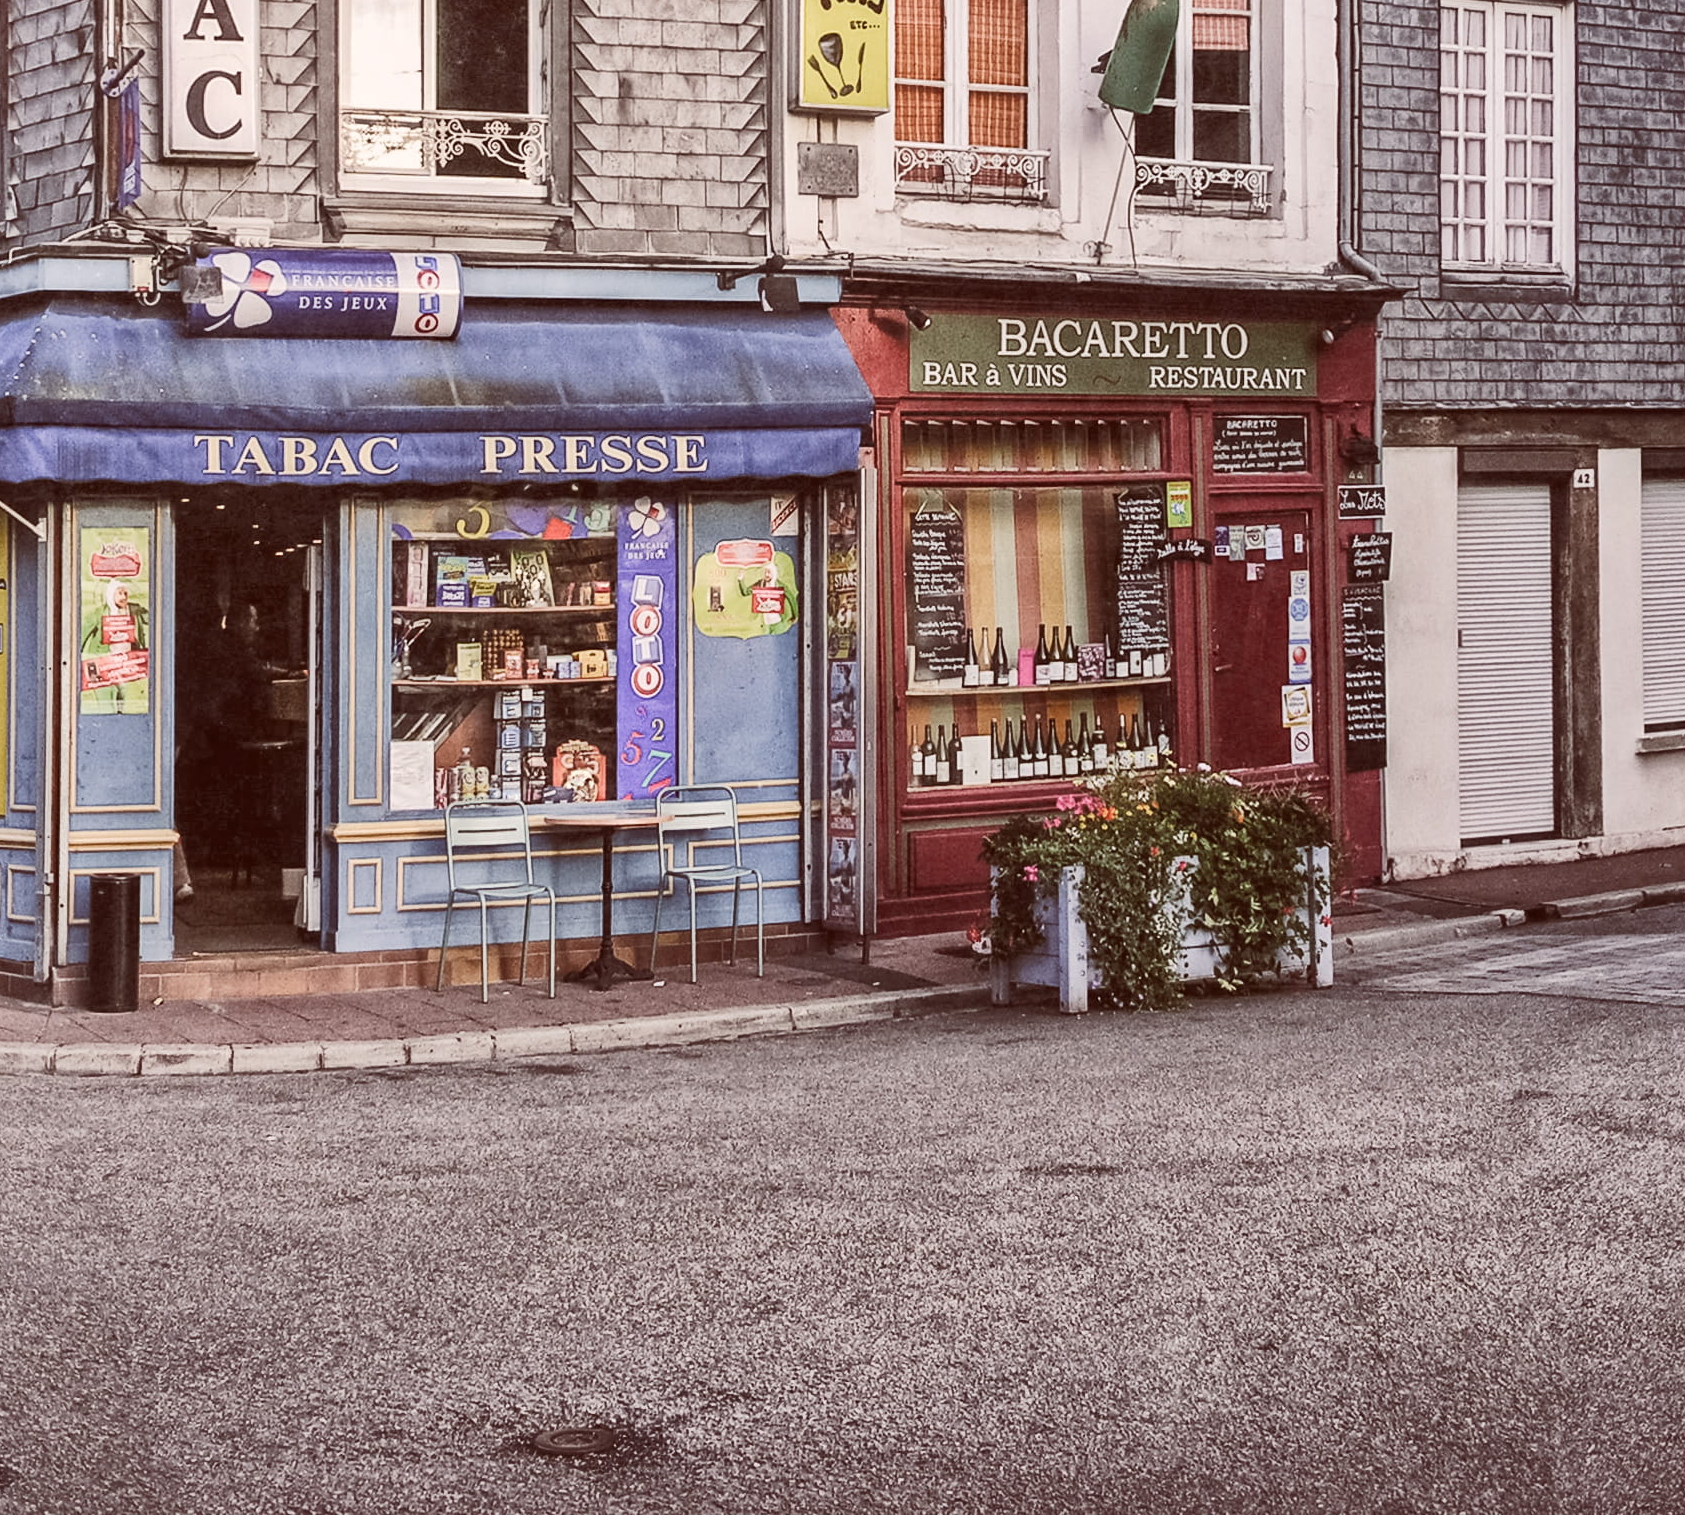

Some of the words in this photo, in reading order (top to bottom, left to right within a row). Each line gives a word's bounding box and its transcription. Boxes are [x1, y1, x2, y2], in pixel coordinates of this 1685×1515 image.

[298, 296, 333, 310] DES
[340, 296, 388, 312] JEUX
[997, 318, 1249, 360] BACARETTO
[922, 362, 978, 386] BAR
[986, 363, 1000, 386] à
[1007, 365, 1067, 387] VINS
[1149, 366, 1306, 390] RESTAURANT
[1226, 419, 1278, 430] BACARETTO
[193, 434, 399, 476] TABAC
[479, 434, 709, 475] PRESSE
[1577, 473, 1590, 484] 42
[631, 576, 664, 698] LOTO
[652, 717, 665, 742] 2
[620, 731, 646, 766] 5
[640, 749, 672, 787] 7
